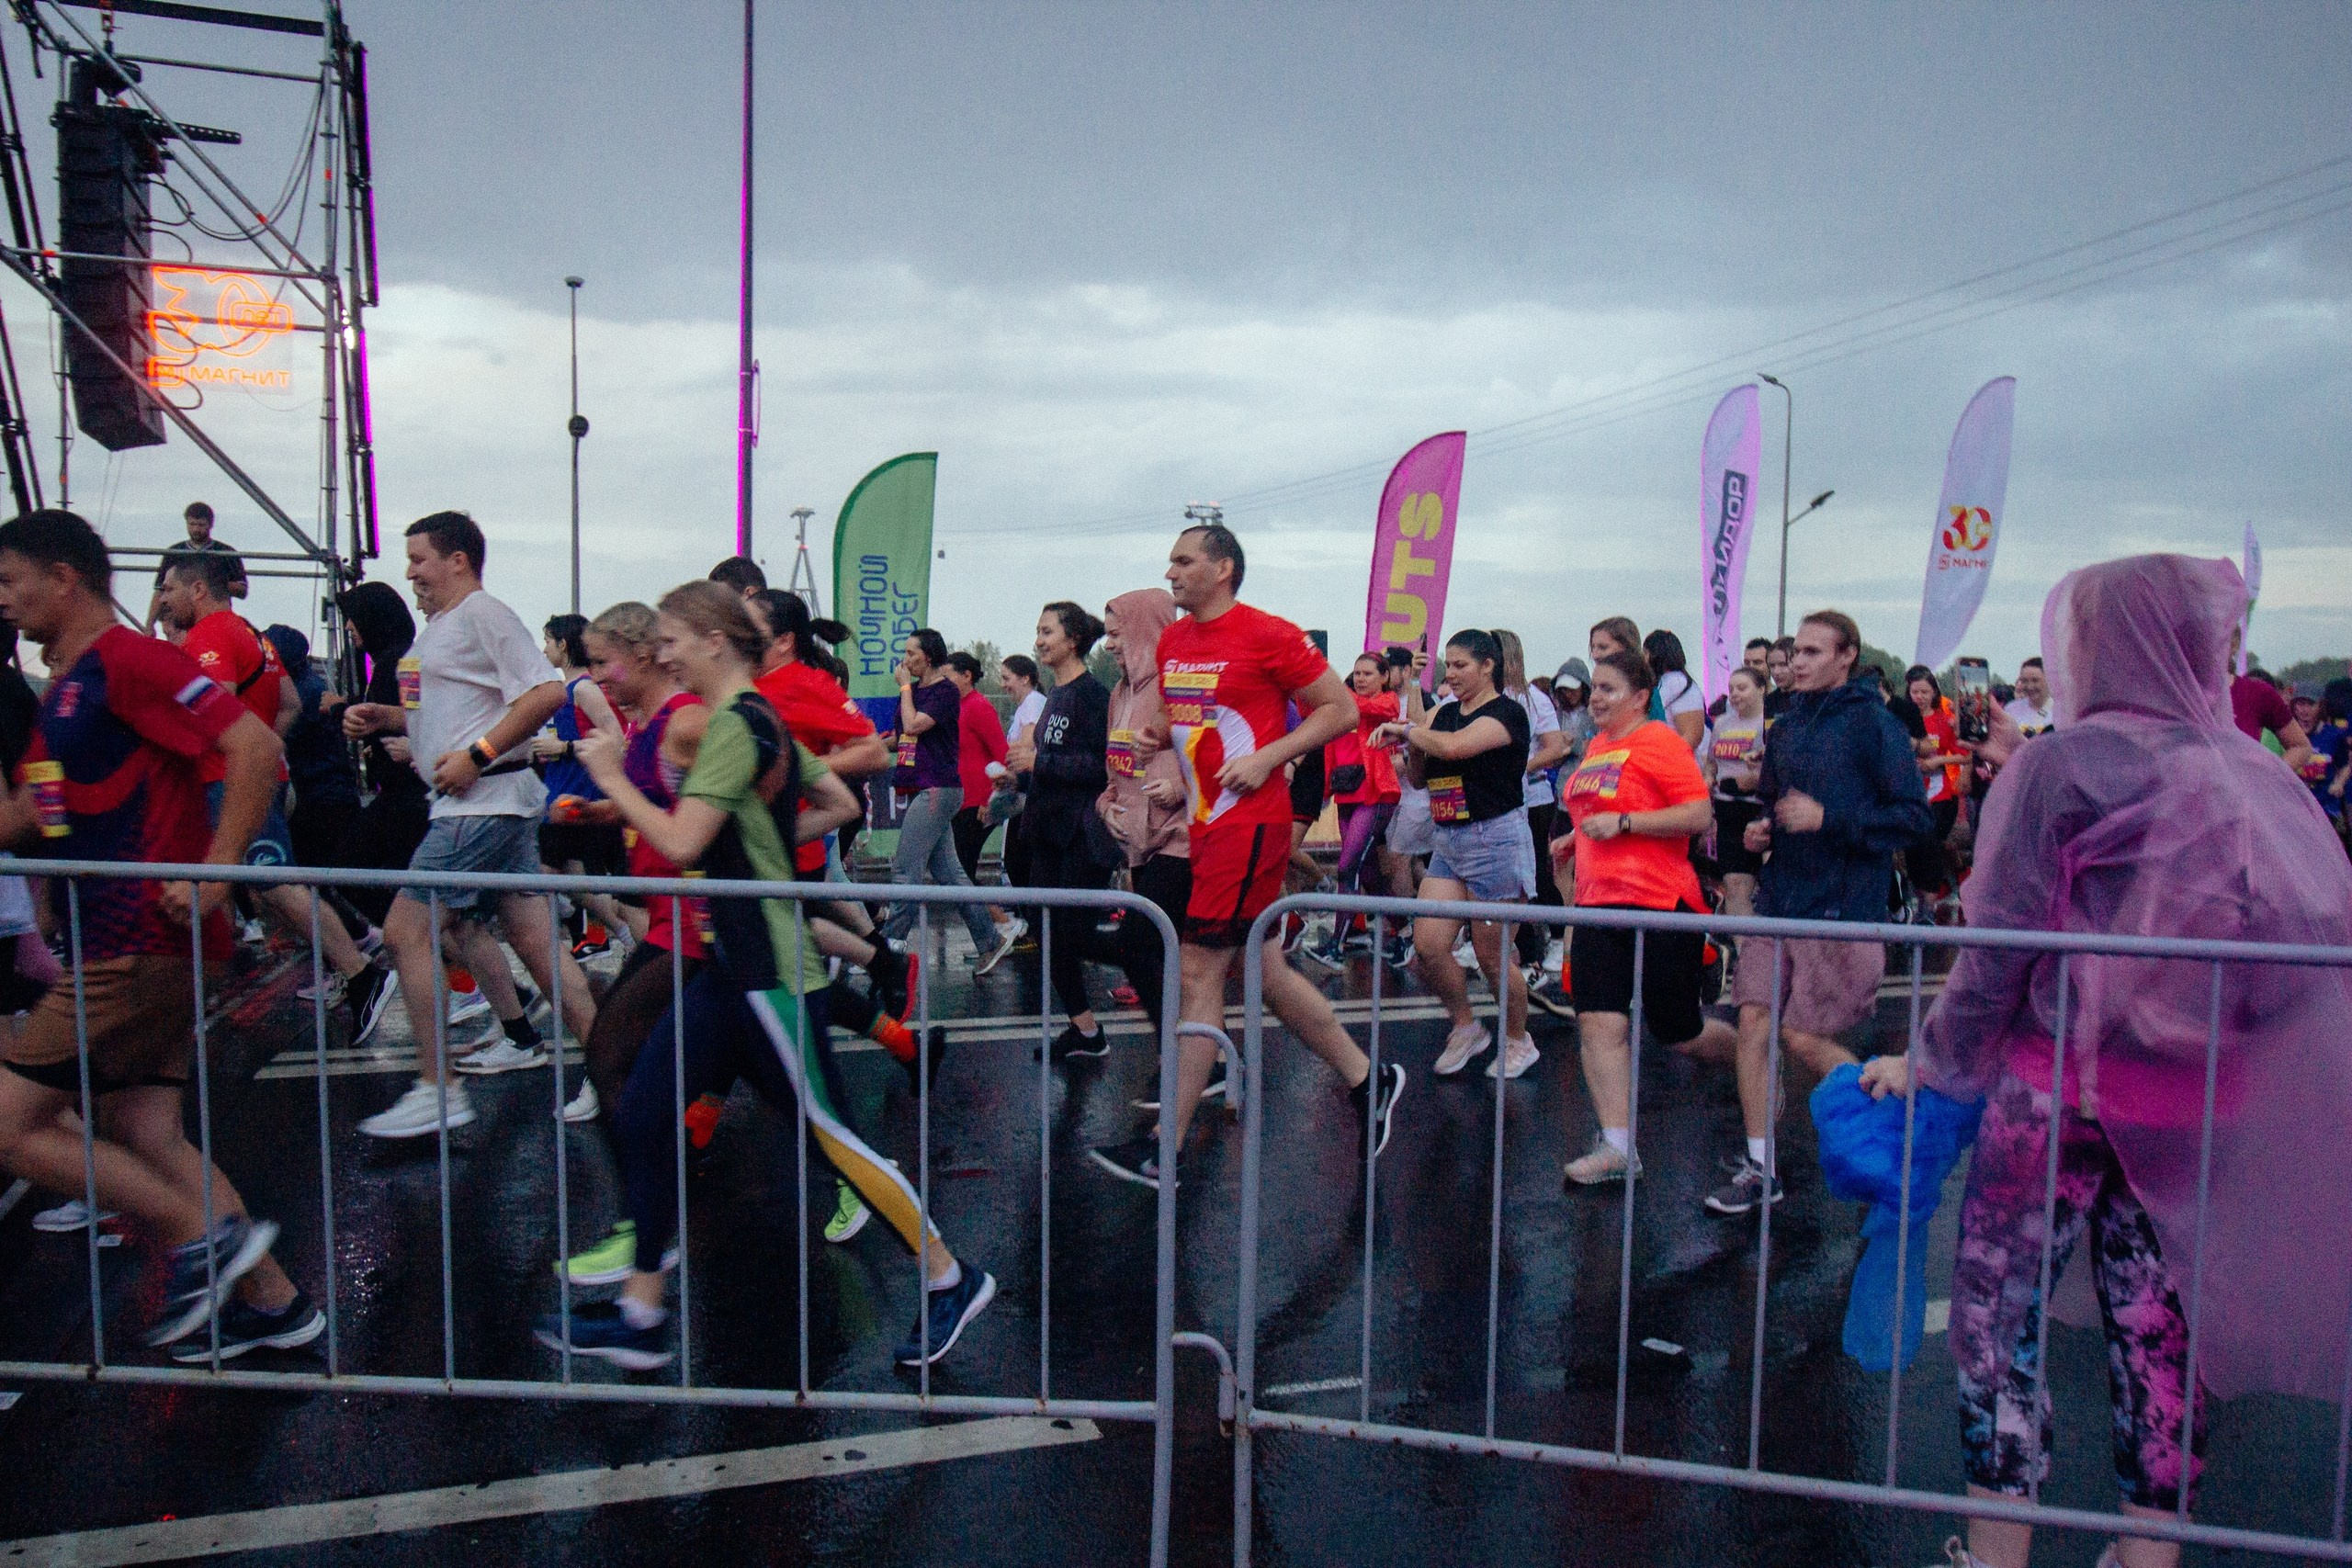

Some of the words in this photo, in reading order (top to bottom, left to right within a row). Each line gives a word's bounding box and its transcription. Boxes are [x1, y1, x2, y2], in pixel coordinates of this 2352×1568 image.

[189, 366, 290, 388] МАГНИТ
[1942, 504, 1991, 551] 30
[859, 554, 888, 676] НОЧНОЙ
